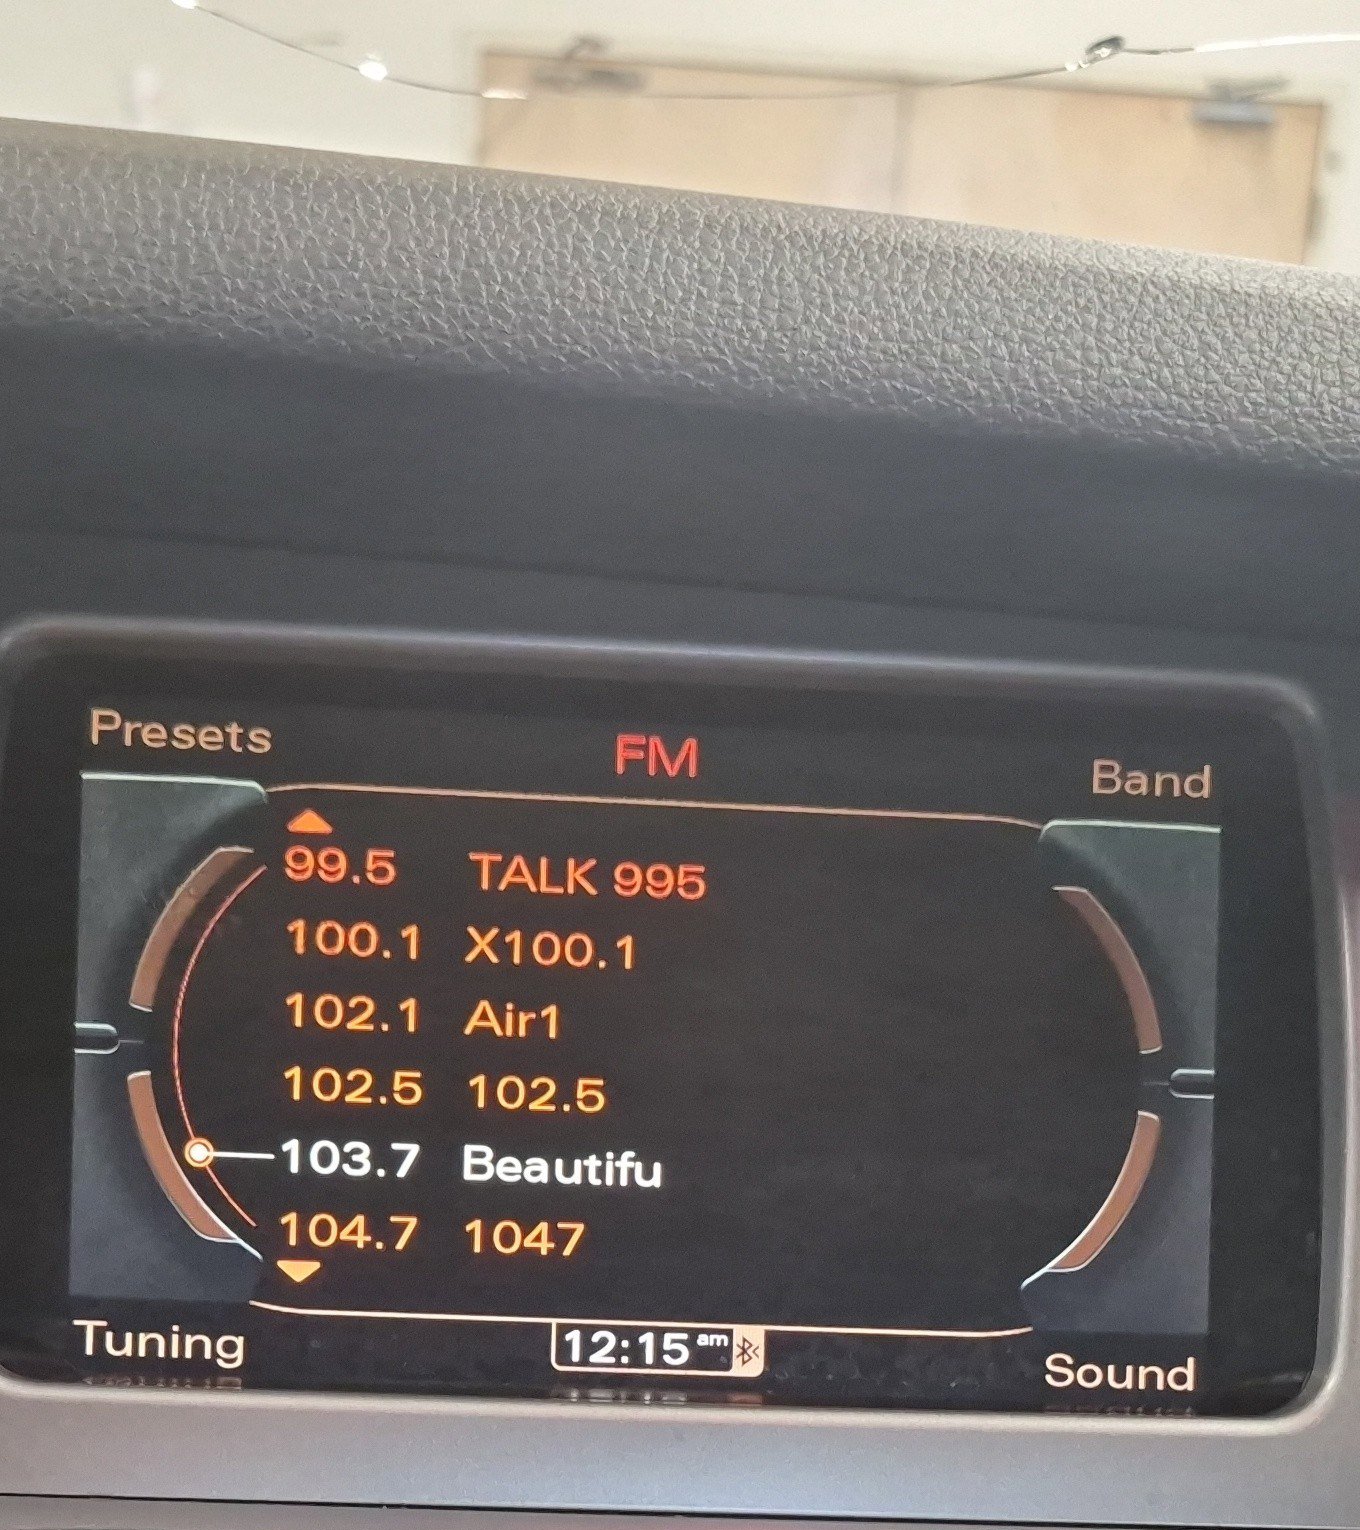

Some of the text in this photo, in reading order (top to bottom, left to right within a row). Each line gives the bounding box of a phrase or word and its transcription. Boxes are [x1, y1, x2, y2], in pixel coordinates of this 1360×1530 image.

[90, 707, 272, 754] Presets
[616, 733, 699, 778] FM
[1092, 758, 1211, 799] Band
[284, 844, 397, 886] 99.5
[468, 851, 707, 901] TALK 995
[286, 918, 420, 960] 100.1
[464, 925, 634, 970] X100.1
[285, 992, 418, 1033] 102.1
[463, 999, 559, 1040] Air1
[283, 1065, 423, 1106] 102.5
[468, 1073, 606, 1114] 102.5
[281, 1138, 421, 1179] 103.7
[462, 1143, 663, 1189] Beautifu
[280, 1211, 418, 1252] 104.7
[465, 1218, 585, 1257] 1047
[72, 1319, 245, 1369] Tuning
[564, 1329, 729, 1366] 12:15 am
[1044, 1352, 1195, 1392] Sound
